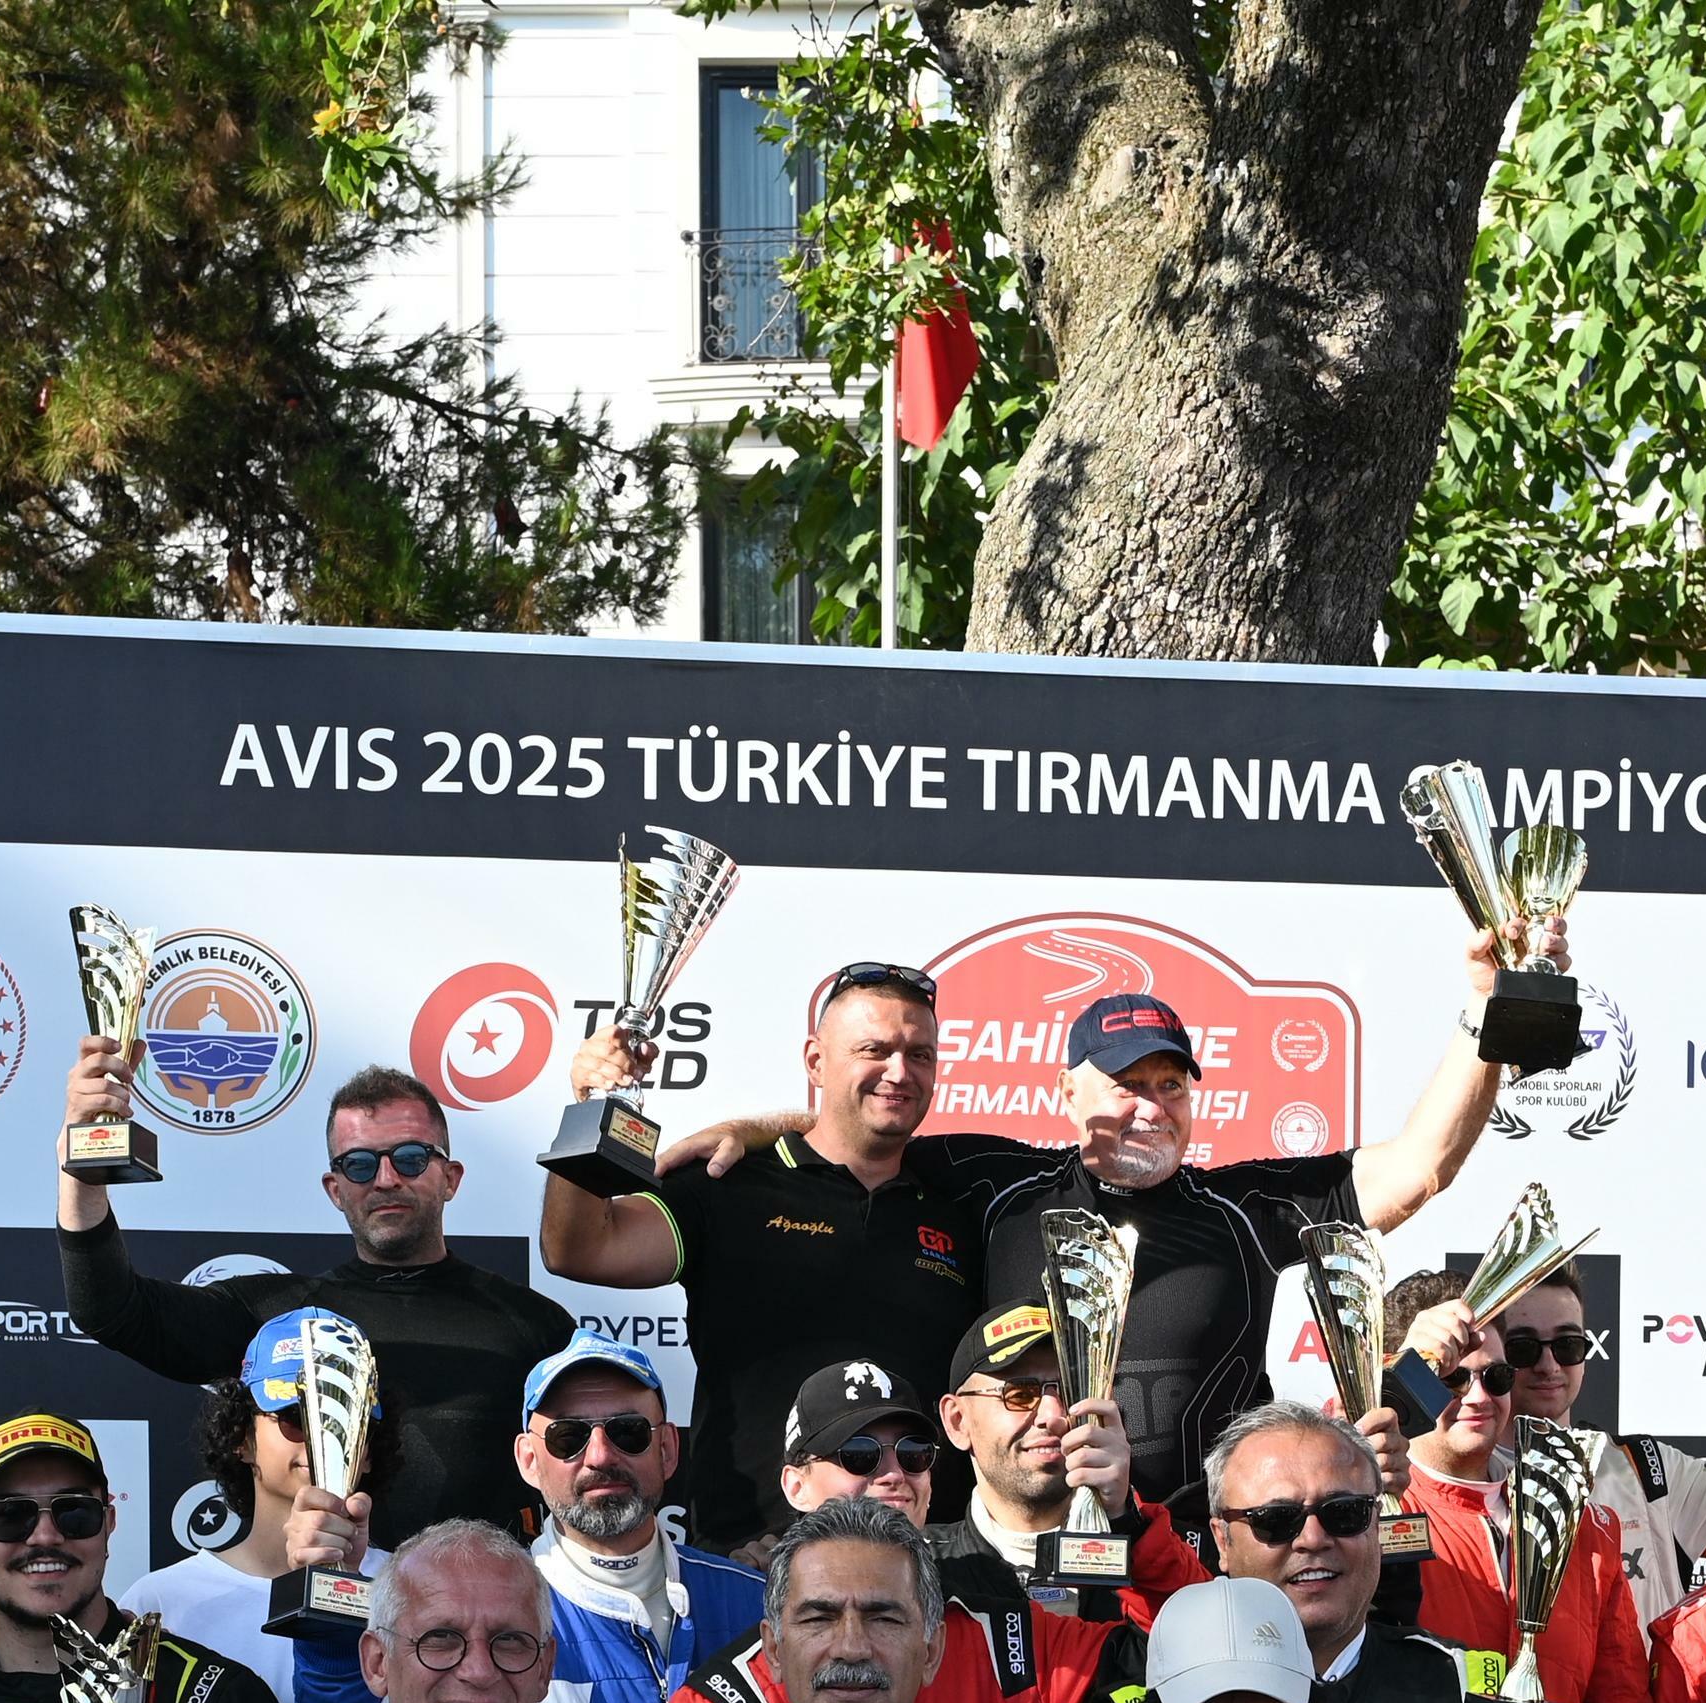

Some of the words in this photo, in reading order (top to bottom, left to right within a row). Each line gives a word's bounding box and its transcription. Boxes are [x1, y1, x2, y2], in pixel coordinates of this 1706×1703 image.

[219, 723, 399, 793] AVIS
[421, 732, 606, 799] 2025
[627, 725, 948, 810] TÜRKİYE
[967, 747, 1385, 825] TIRMANMA
[144, 948, 194, 990] GEMLİK
[198, 946, 288, 995] BELEDİYESİ
[1515, 1095, 1543, 1106] SPOR
[1547, 1093, 1588, 1107] KULÜBÜ
[1553, 1080, 1603, 1092] SPORLARI
[192, 1110, 235, 1123] 1878
[766, 1215, 835, 1235] Ağaoğlu
[580, 1316, 689, 1347] RYPE
[992, 1310, 1051, 1338] PIRE
[1640, 1438, 1664, 1487] sparco
[590, 1555, 639, 1571] sparco
[1006, 1613, 1025, 1675] sparco
[1483, 1657, 1500, 1696] parco
